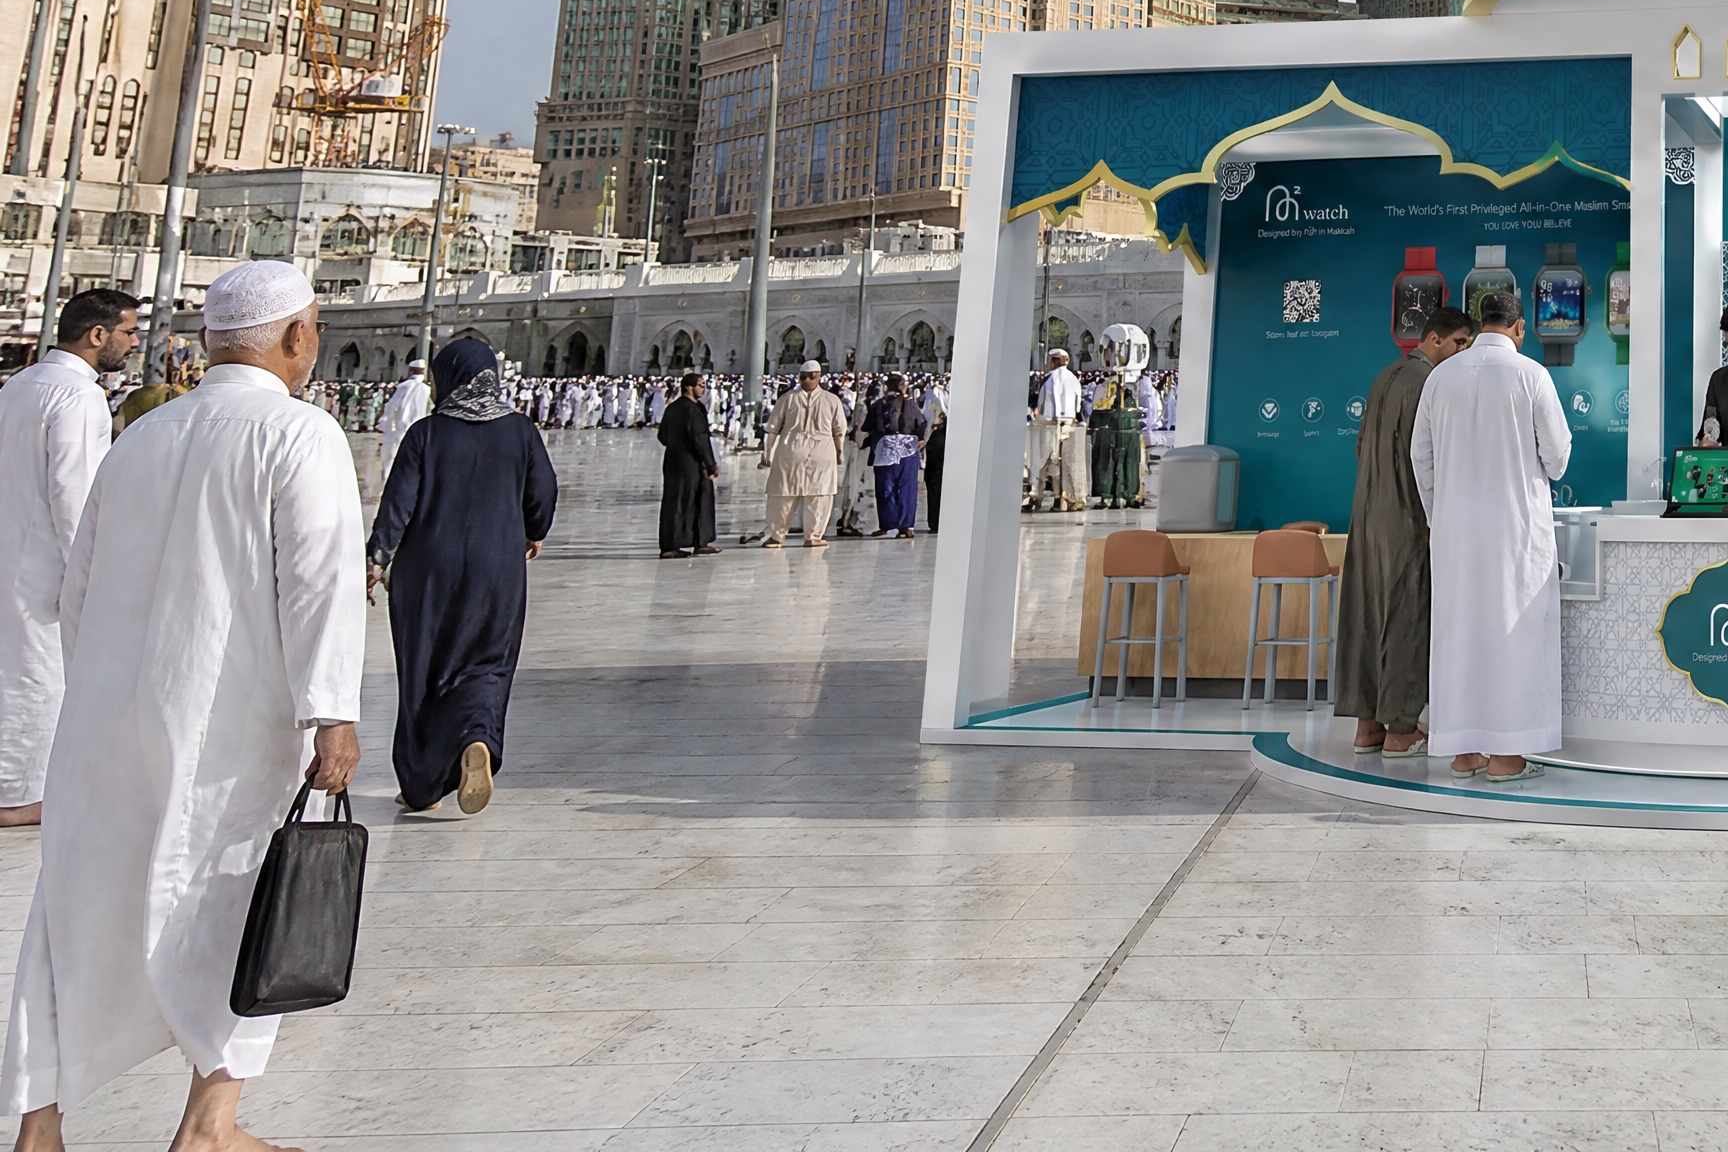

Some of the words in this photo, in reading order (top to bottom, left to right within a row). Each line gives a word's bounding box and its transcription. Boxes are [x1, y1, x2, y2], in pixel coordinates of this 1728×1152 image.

[1303, 204, 1349, 220] watch
[1408, 204, 1444, 216] World's
[1446, 203, 1468, 215] First
[1470, 202, 1516, 217] Privileged
[1519, 201, 1571, 213] All-in-One
